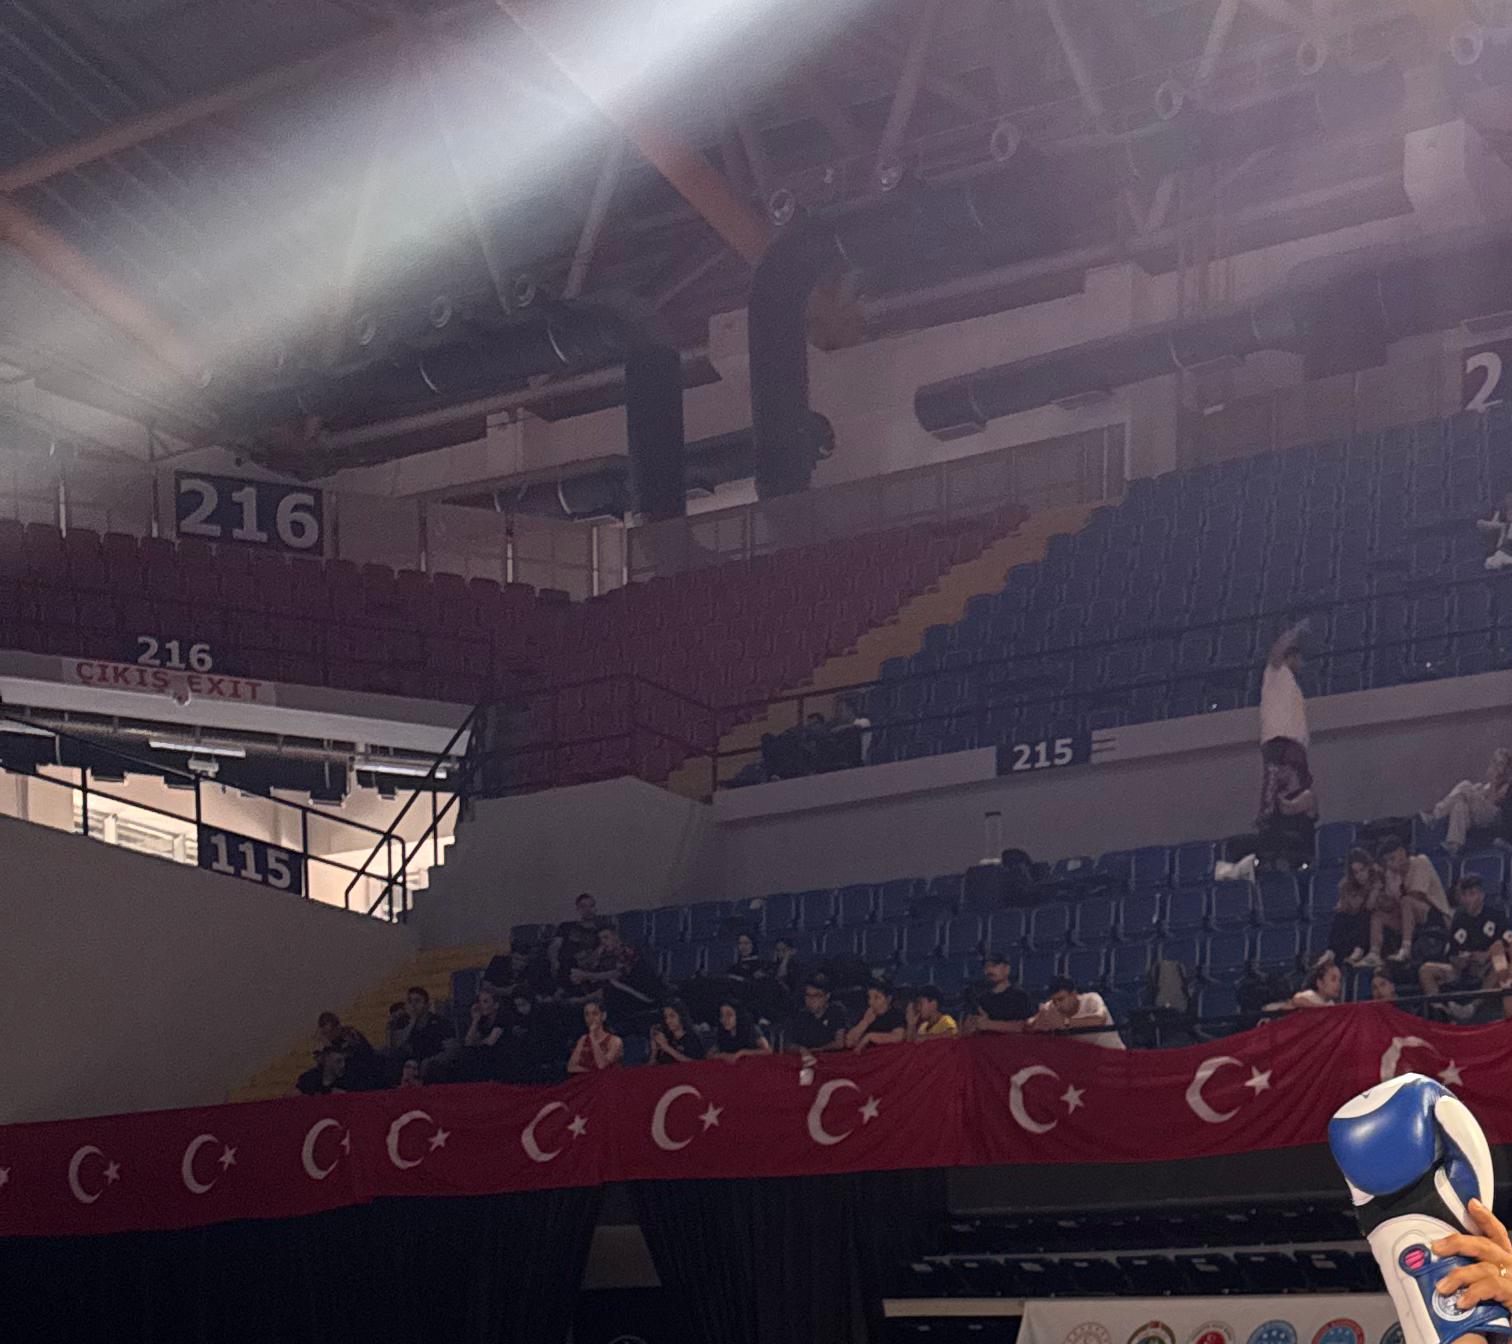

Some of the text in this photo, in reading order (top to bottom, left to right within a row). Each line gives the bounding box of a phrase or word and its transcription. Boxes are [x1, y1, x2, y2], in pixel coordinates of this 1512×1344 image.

[178, 478, 320, 550] 216
[137, 636, 213, 673] 216
[1012, 737, 1074, 771] 215
[210, 833, 291, 889] 115
